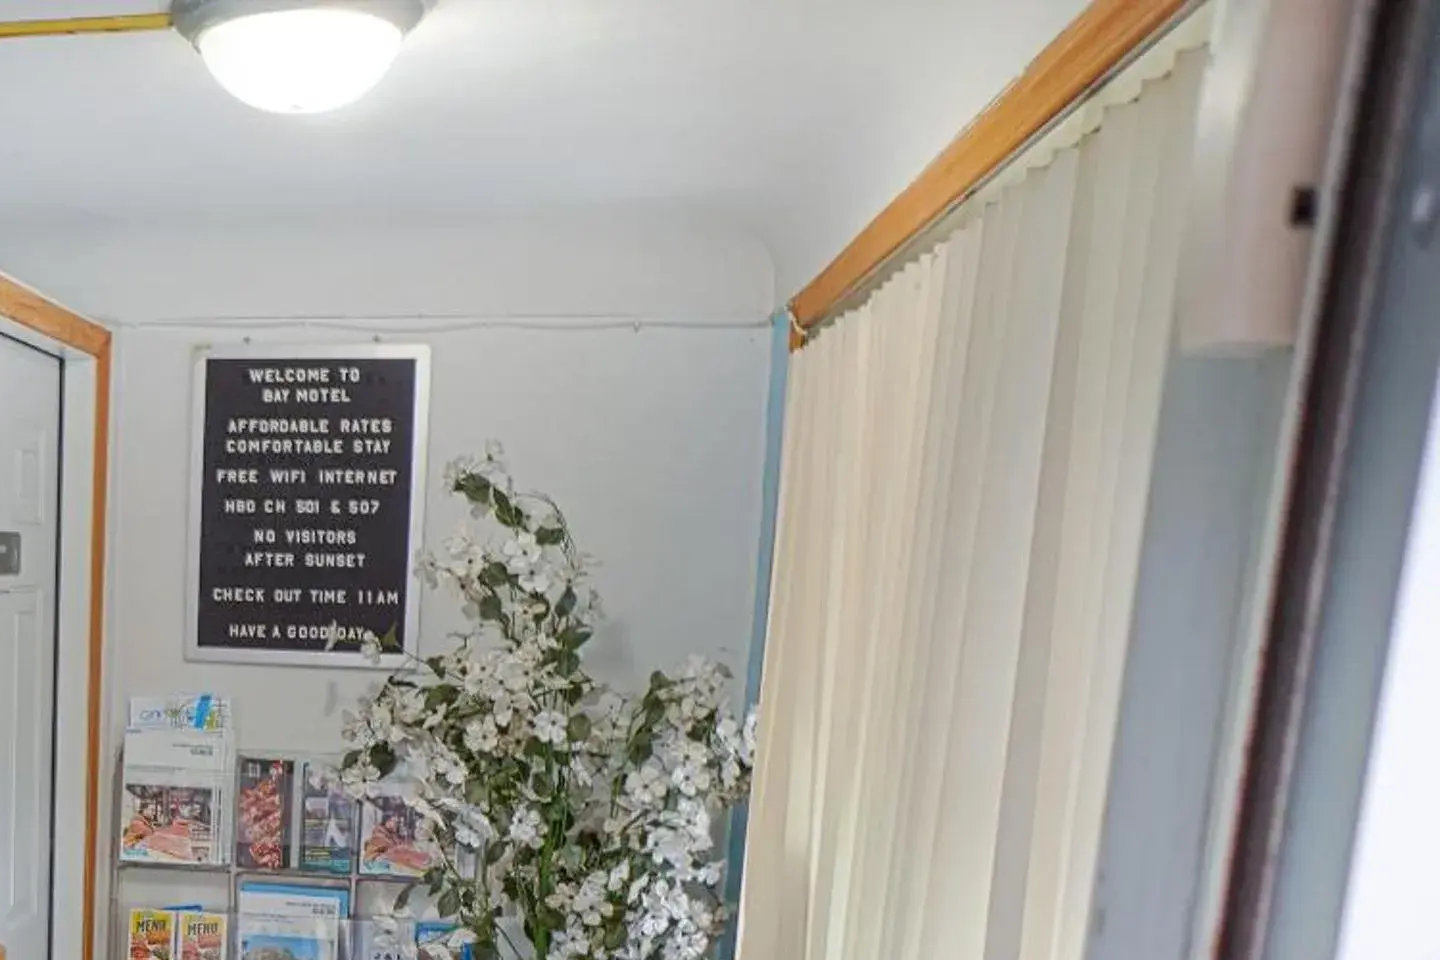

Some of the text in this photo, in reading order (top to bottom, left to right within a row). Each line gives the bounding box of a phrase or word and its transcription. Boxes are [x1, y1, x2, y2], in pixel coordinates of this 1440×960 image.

[249, 368, 361, 383] WELCOME TO
[263, 388, 351, 403] BAY MOTEL
[227, 418, 392, 434] AFFORDABLE RATES
[226, 439, 391, 454] COMFORTABLE STAY
[216, 469, 398, 485] FREE WIFI INTERNET
[225, 499, 380, 515] HBO CH 501 & 507
[254, 529, 357, 545] NO VISITORS
[245, 552, 366, 568] AFTER SUNSET
[212, 588, 399, 605] CHECK OUT TIME 11AM
[229, 624, 364, 641] HAVE A GOOD DAY
[187, 922, 219, 935] MENU
